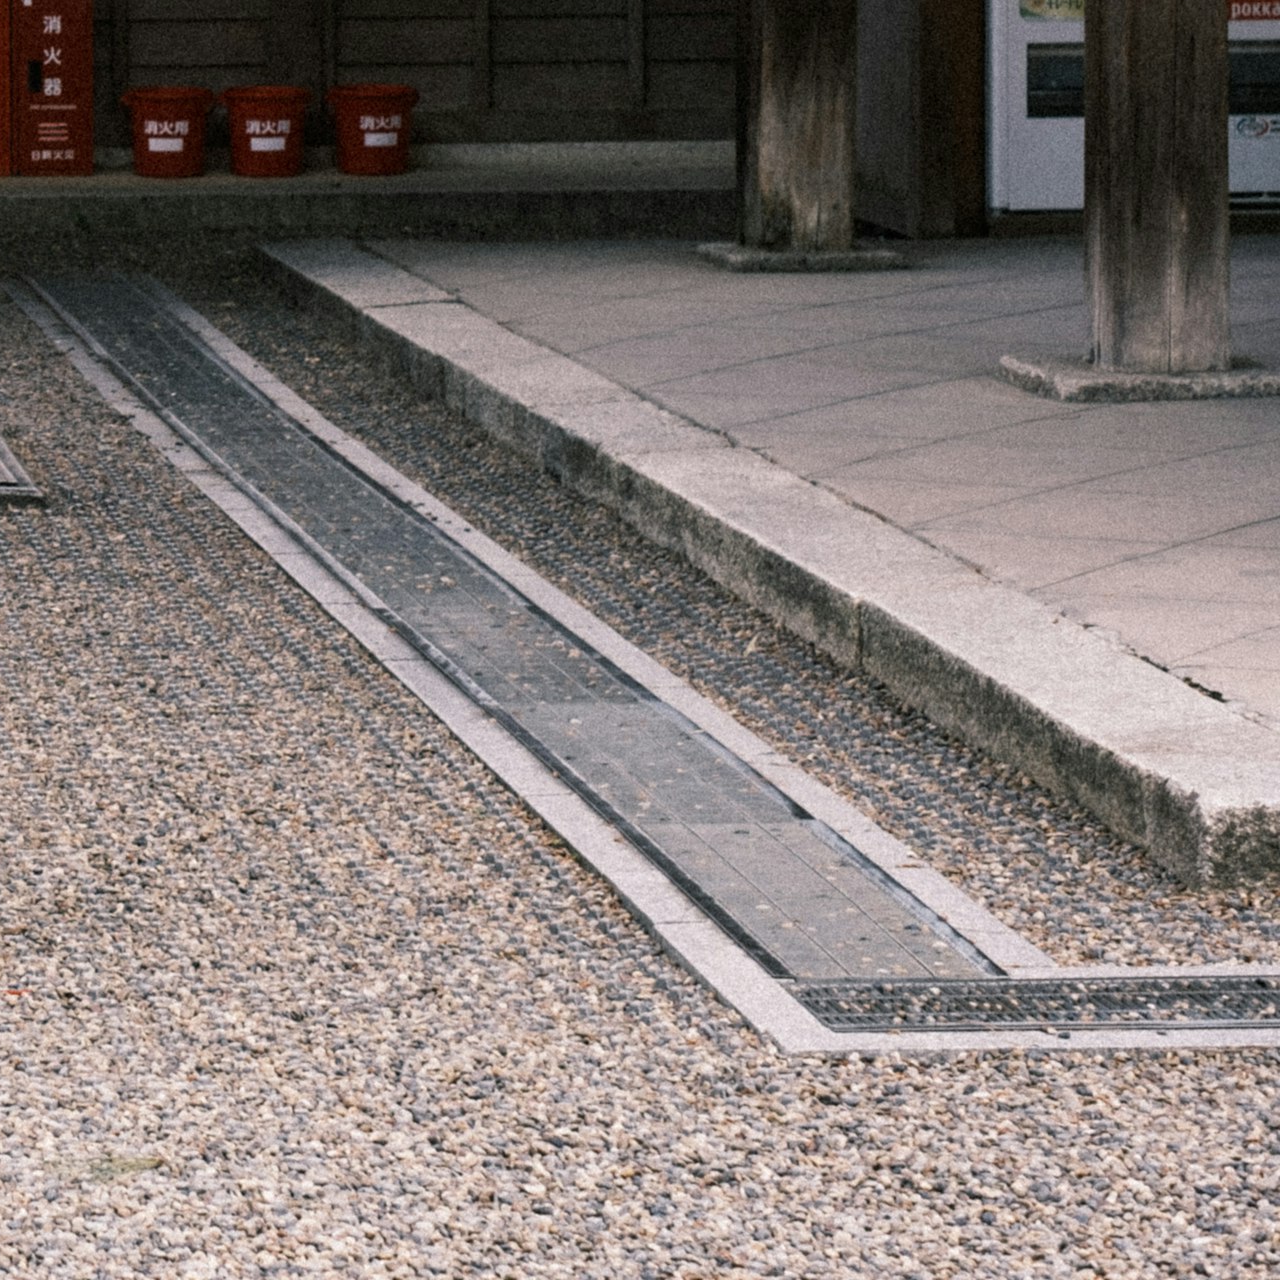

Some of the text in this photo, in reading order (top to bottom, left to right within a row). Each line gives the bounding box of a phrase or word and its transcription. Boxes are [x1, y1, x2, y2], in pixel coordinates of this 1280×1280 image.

[43, 15, 63, 97] 消火器
[144, 120, 189, 135] 消火用
[246, 120, 290, 134] 消火用
[359, 115, 402, 131] 消火用
